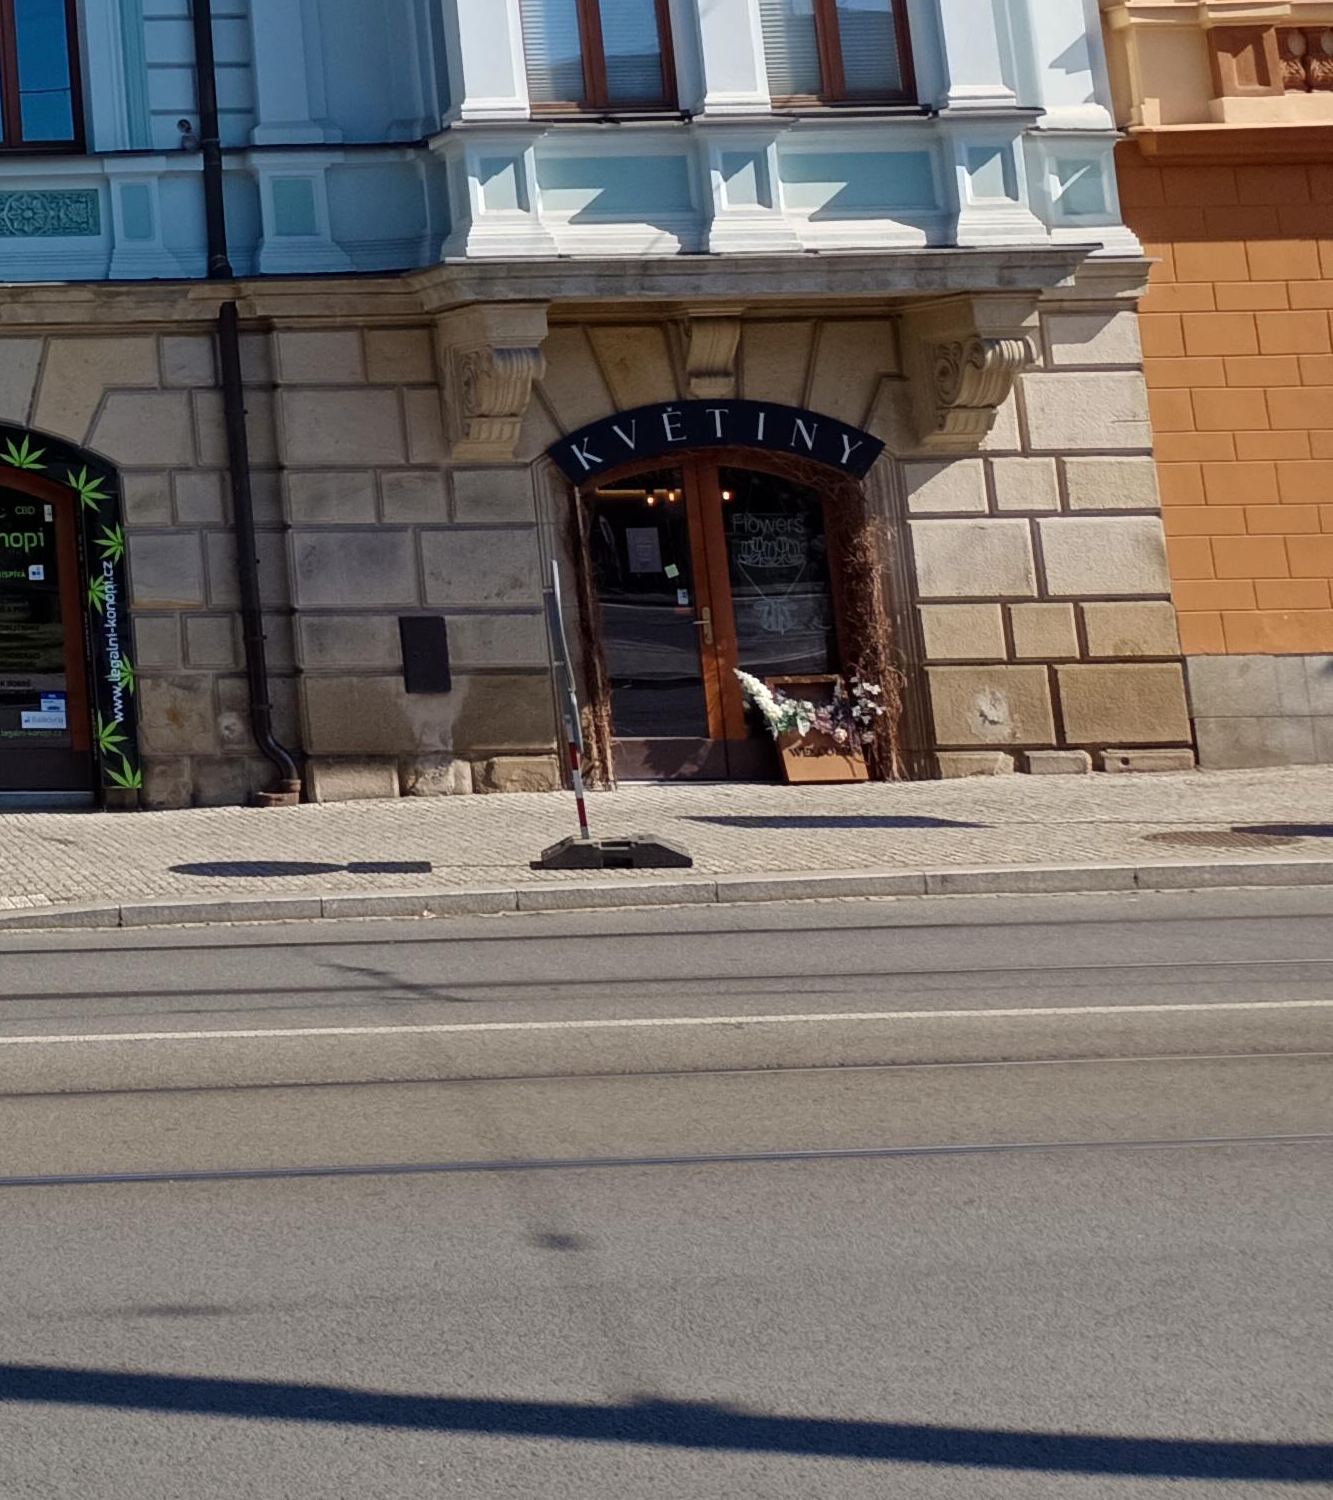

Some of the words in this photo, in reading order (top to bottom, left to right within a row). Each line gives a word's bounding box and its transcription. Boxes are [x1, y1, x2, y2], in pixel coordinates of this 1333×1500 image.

[571, 406, 863, 471] KVĚTINY
[15, 506, 35, 515] CBD
[733, 511, 805, 534] Flowers
[103, 560, 125, 723] www.legalni-konopi.cz
